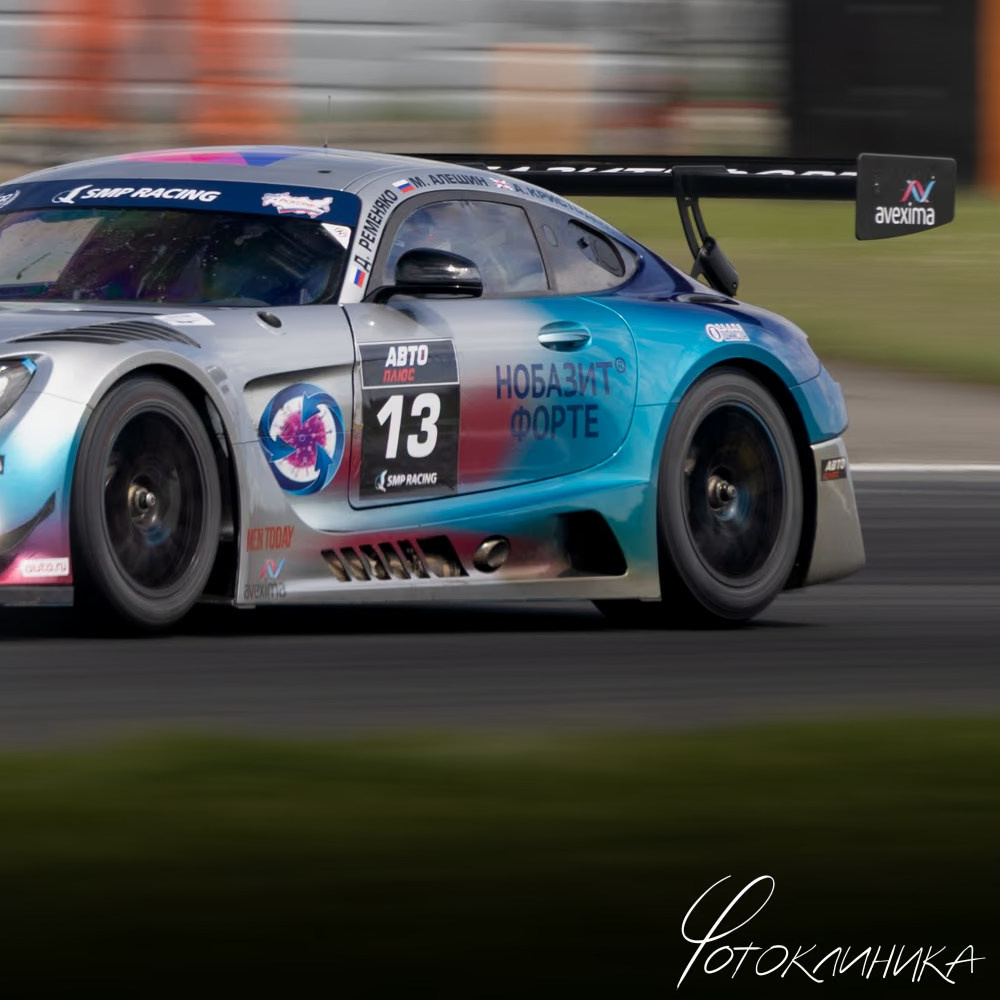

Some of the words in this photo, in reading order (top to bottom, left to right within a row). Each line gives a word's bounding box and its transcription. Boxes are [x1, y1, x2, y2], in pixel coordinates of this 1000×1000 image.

[428, 173, 489, 188] АЛЕШИН
[80, 187, 135, 199] SMP
[130, 187, 222, 203] RACING
[359, 188, 399, 253] РЕМЕНЯКО
[874, 202, 936, 226] avexima
[384, 344, 429, 368] АВТО
[383, 367, 416, 384] ПЛЮС
[376, 392, 441, 460] 13
[510, 404, 600, 441] ФОРТЕ
[386, 474, 406, 487] SMP
[406, 472, 438, 486] RACING
[244, 577, 287, 600] avexima
